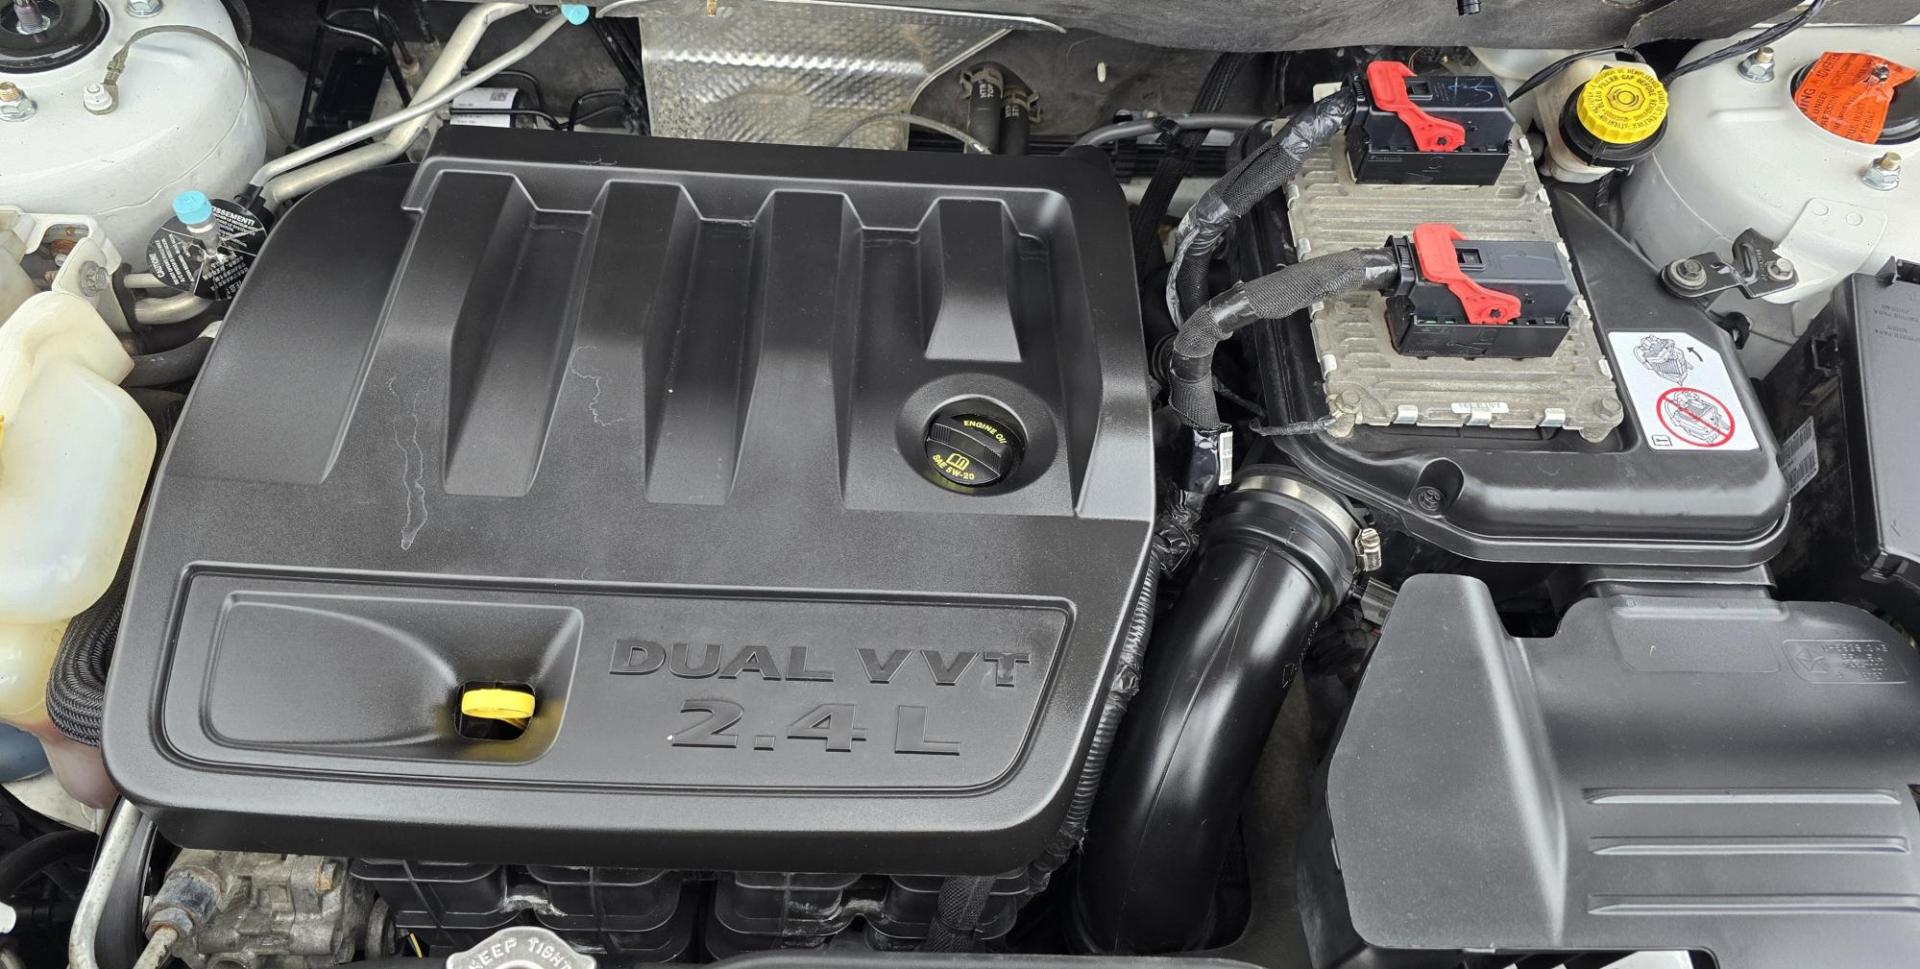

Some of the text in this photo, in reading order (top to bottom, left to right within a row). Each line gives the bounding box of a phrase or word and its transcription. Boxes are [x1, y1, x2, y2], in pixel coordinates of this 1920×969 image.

[963, 420, 1008, 444] ENGINE OIL
[932, 454, 975, 480] SAE 5W-20
[609, 640, 1030, 688] DUAL VVT
